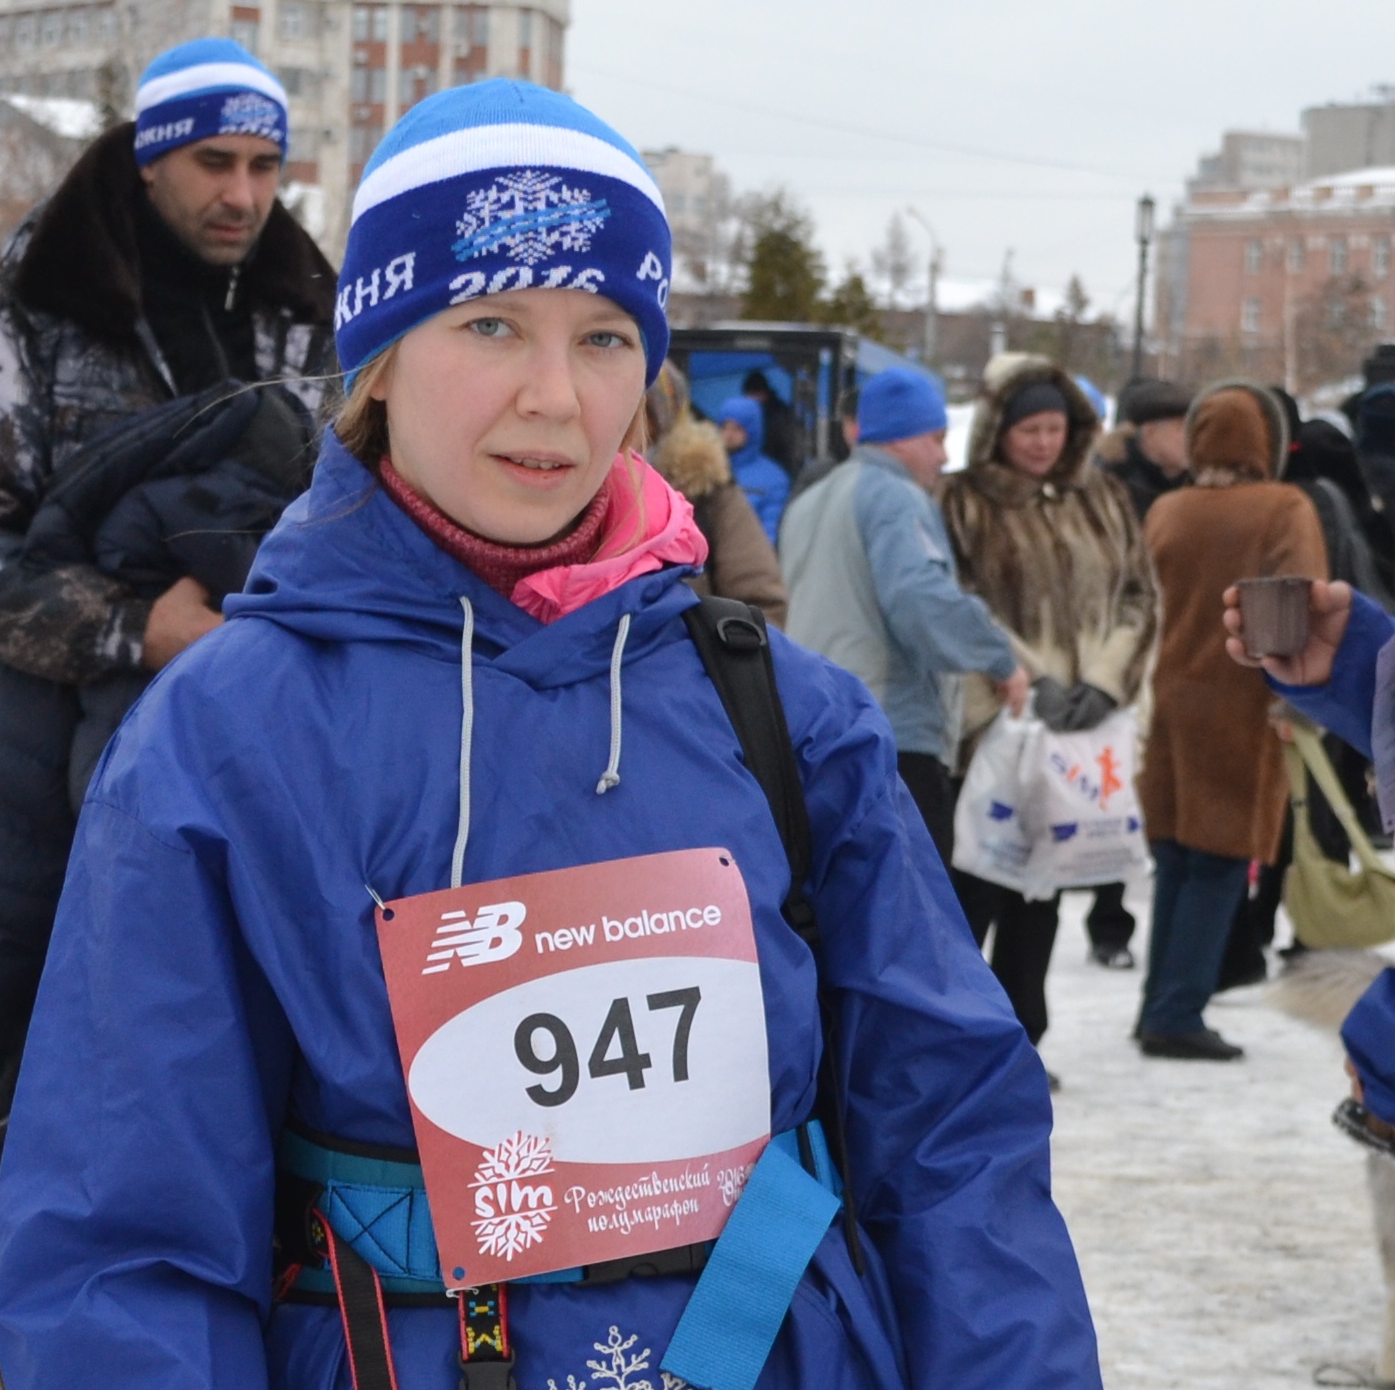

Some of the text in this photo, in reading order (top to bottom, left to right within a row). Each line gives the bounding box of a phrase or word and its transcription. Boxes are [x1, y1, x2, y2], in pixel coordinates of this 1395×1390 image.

[422, 901, 526, 975] NB
[535, 905, 721, 953] new balance
[513, 986, 702, 1108] 947
[564, 1162, 711, 1213] Рождественский
[587, 1198, 700, 1235] полумарафон
